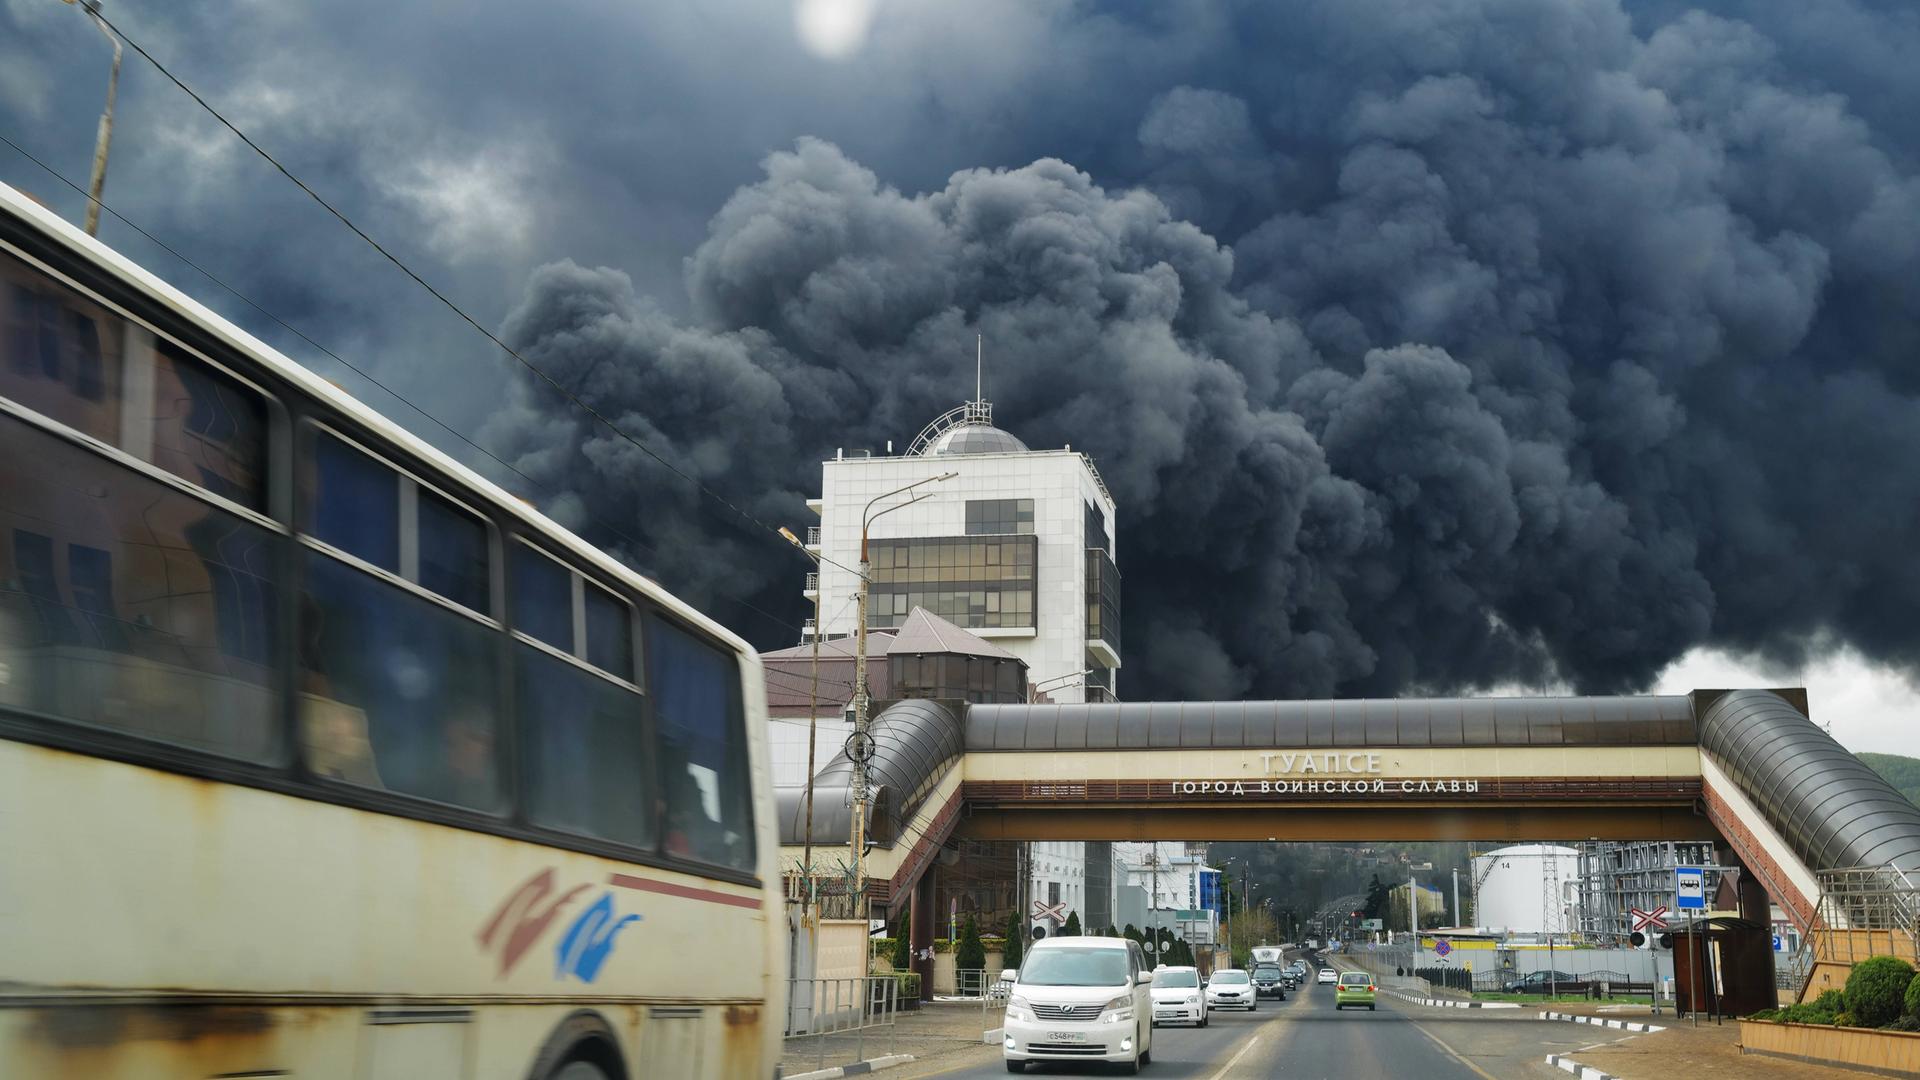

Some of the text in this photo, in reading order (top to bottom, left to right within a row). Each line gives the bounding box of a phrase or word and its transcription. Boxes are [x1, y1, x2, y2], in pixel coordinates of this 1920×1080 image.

[1260, 752, 1381, 773] ТУАПСЕ
[1172, 779, 1479, 795] ГОРОД ВОИНСКОЙ СЛАВЫ
